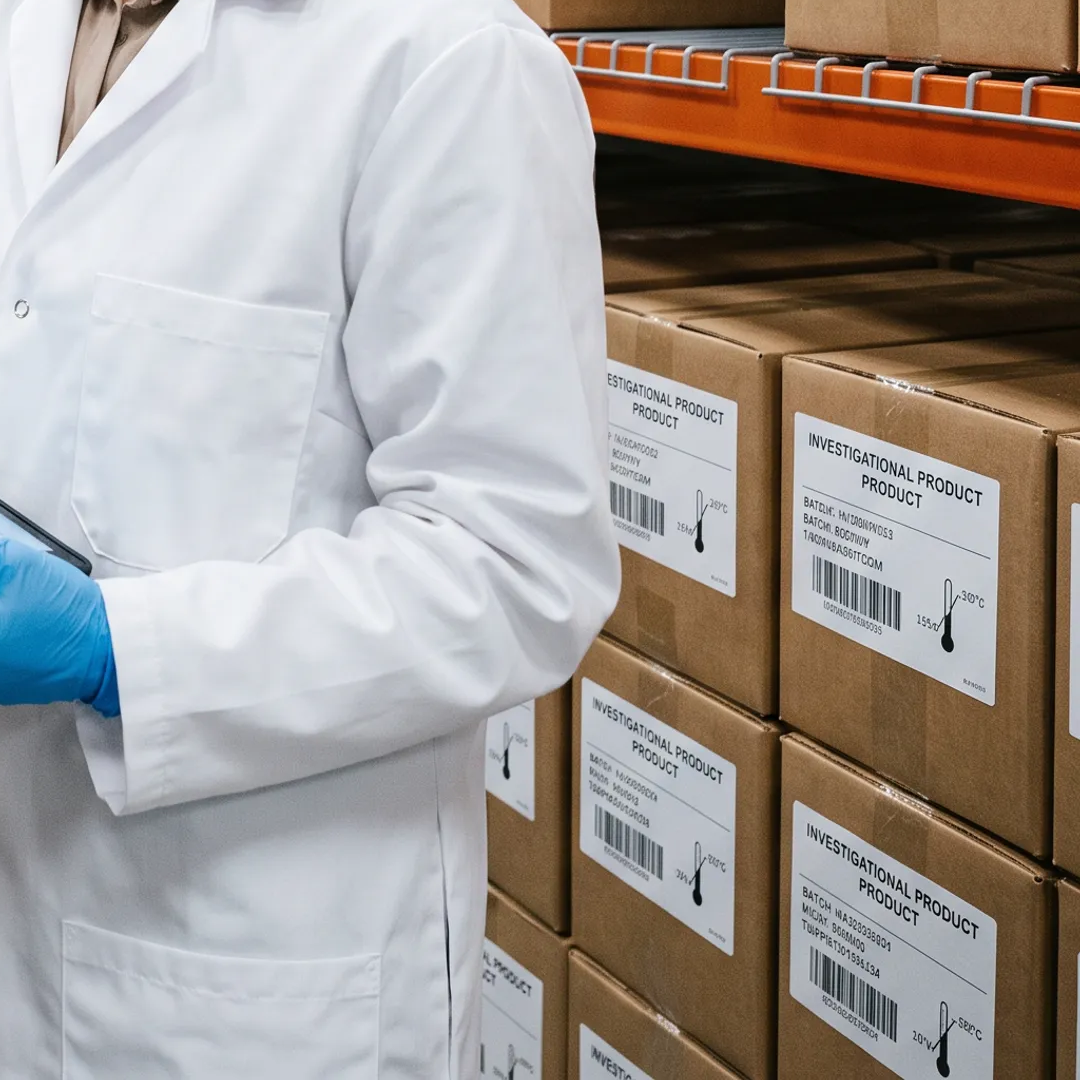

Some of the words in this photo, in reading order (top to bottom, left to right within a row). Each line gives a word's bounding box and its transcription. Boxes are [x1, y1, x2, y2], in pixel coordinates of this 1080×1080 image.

[607, 372, 672, 408] ESTIGATIONAL
[675, 396, 724, 426] PRODUCT
[632, 402, 679, 430] PRODUCT
[808, 432, 914, 483] INVESTIGATIONAL
[917, 469, 983, 507] PRODUCT
[861, 473, 923, 509] PRODUCT
[592, 697, 673, 756] INVESTIGATIONAL
[675, 745, 723, 785] PRODUCT
[632, 740, 679, 779] PRODUCT
[806, 823, 912, 900] INVESTIGATIONAL
[914, 888, 980, 940] PRODUCT
[859, 877, 920, 927] PRODUCT
